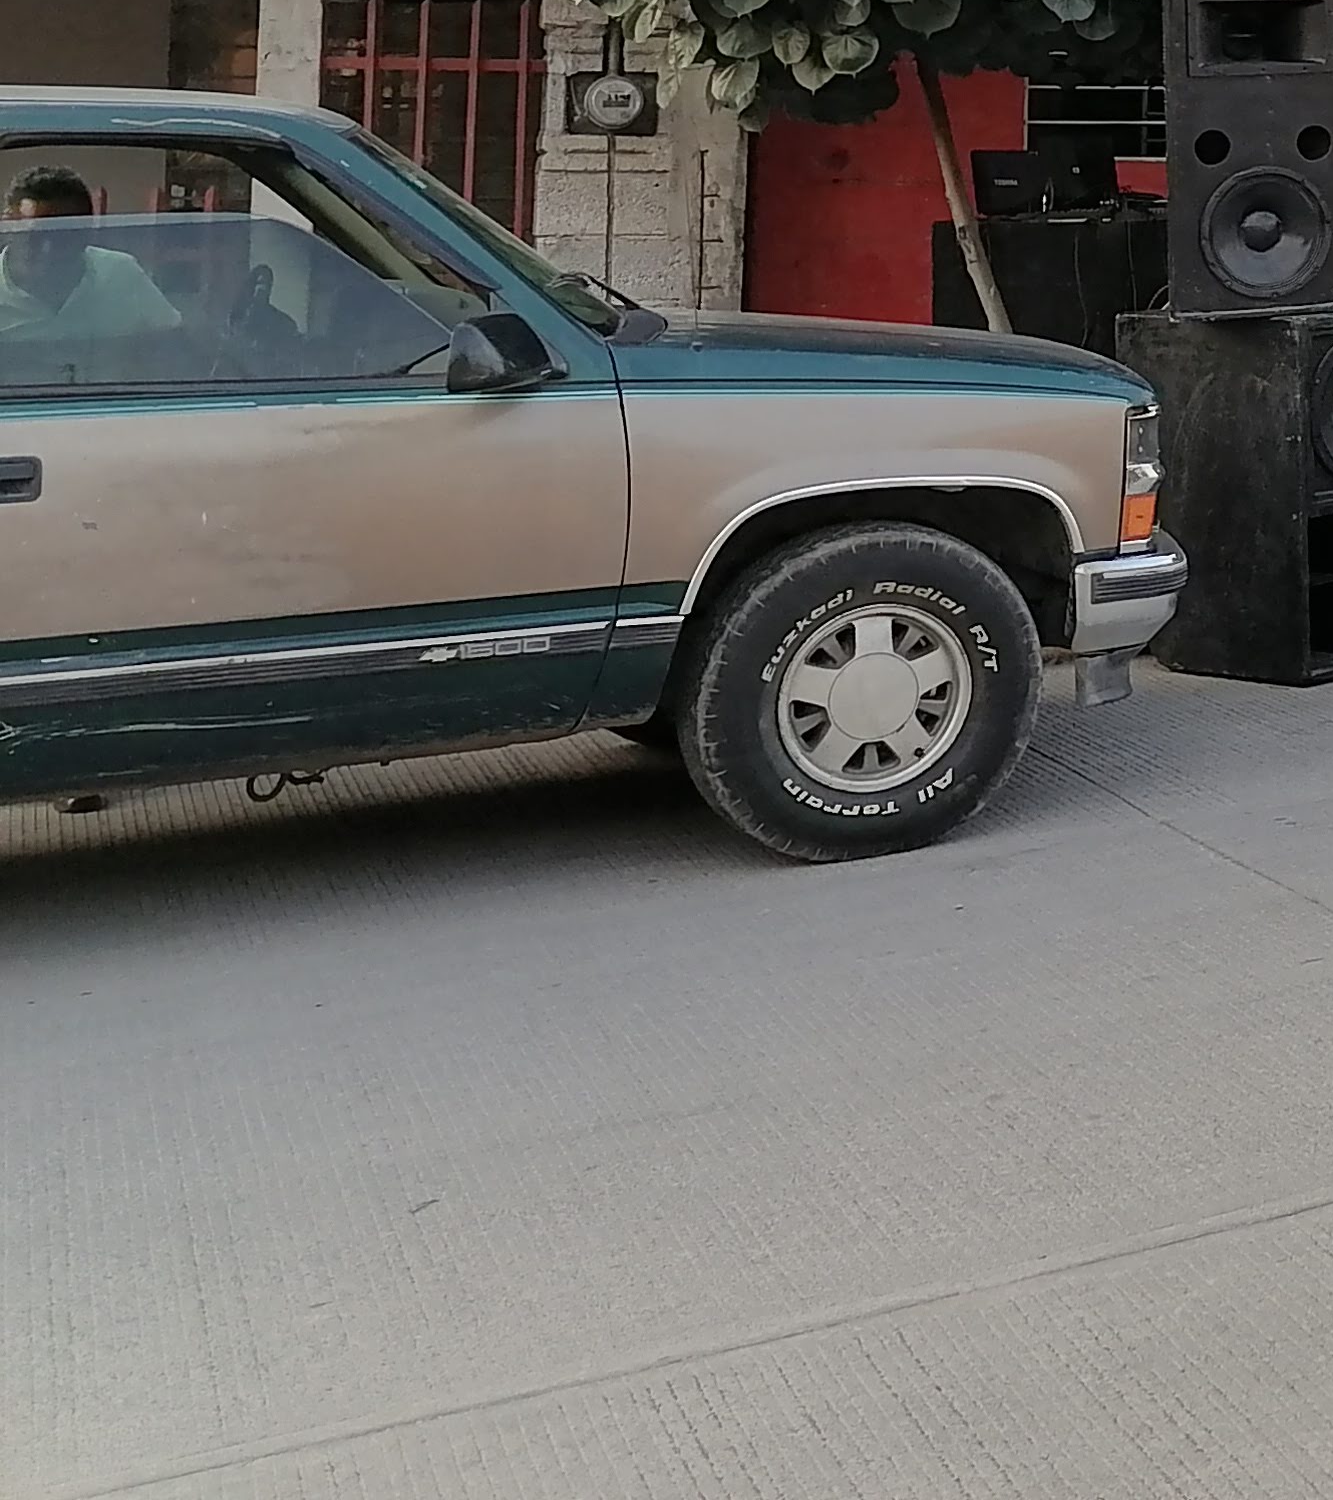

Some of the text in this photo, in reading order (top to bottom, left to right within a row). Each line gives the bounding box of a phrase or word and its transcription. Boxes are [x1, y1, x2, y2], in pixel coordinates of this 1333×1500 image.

[460, 636, 550, 660] 1500
[761, 589, 854, 682] Euzkadi
[873, 581, 967, 615] Radial
[782, 767, 954, 816] All Terrain
